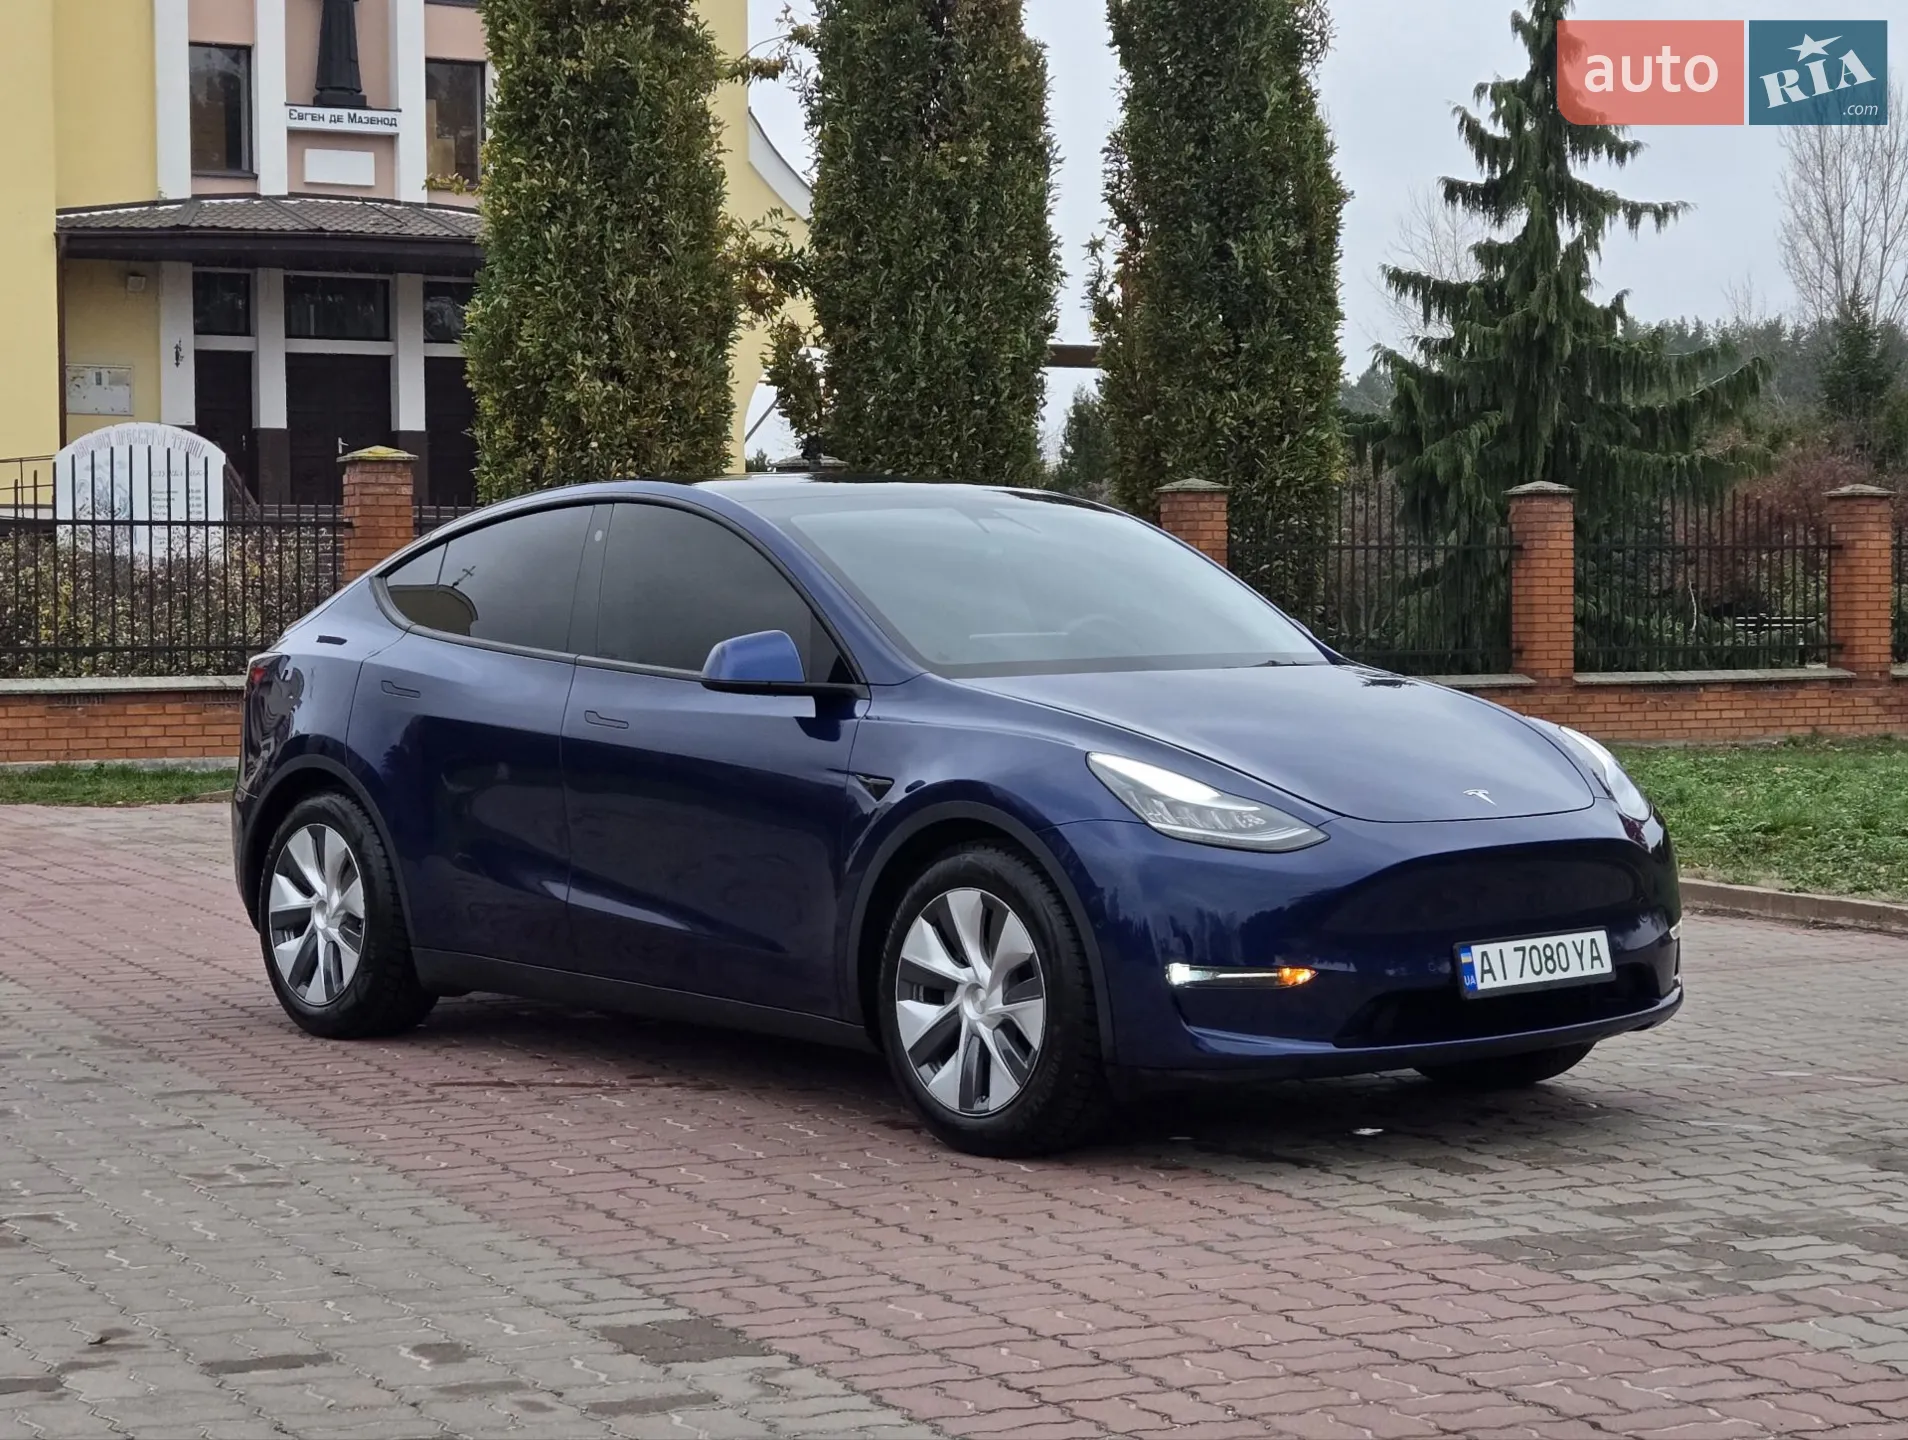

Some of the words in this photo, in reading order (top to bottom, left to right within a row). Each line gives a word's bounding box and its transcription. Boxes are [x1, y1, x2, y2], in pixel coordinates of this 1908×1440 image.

[1480, 948, 1508, 984] AI
[1513, 941, 1570, 979] 7080
[1572, 937, 1605, 972] YA
[1463, 975, 1476, 986] UA
